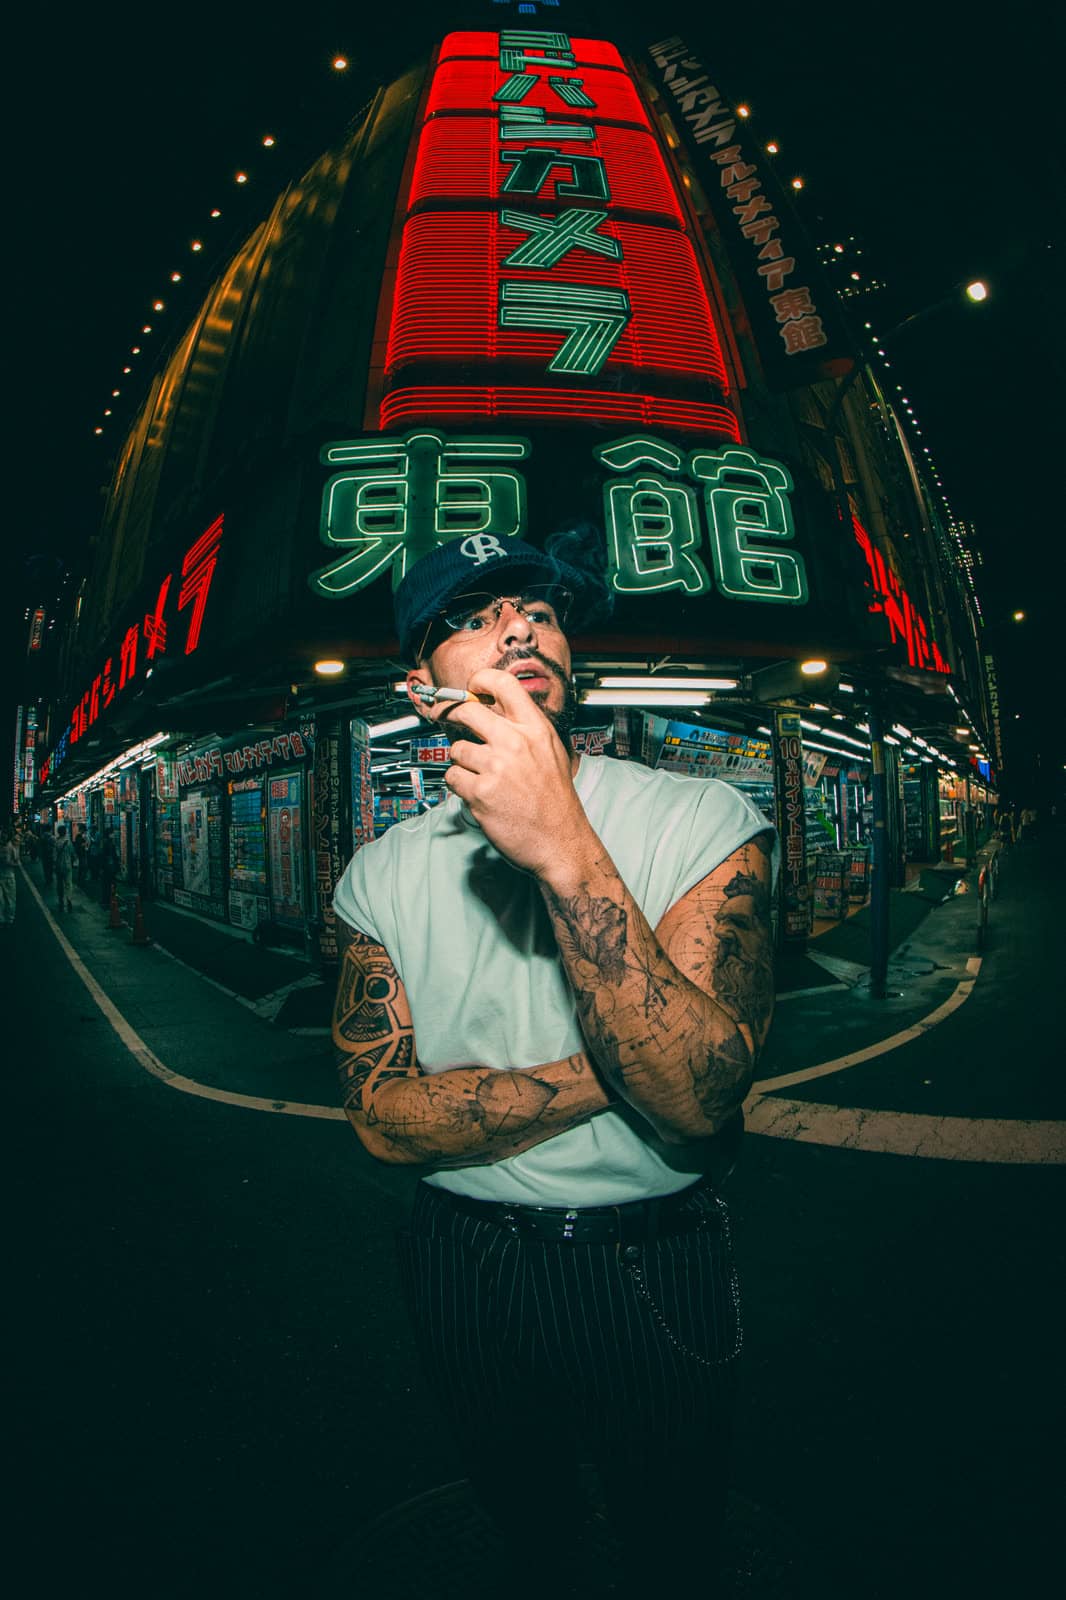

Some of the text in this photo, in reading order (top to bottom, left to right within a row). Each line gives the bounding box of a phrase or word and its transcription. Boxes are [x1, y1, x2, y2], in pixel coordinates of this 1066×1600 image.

[495, 30, 631, 374] ヨドバシカメラ
[308, 430, 808, 606] 東館
